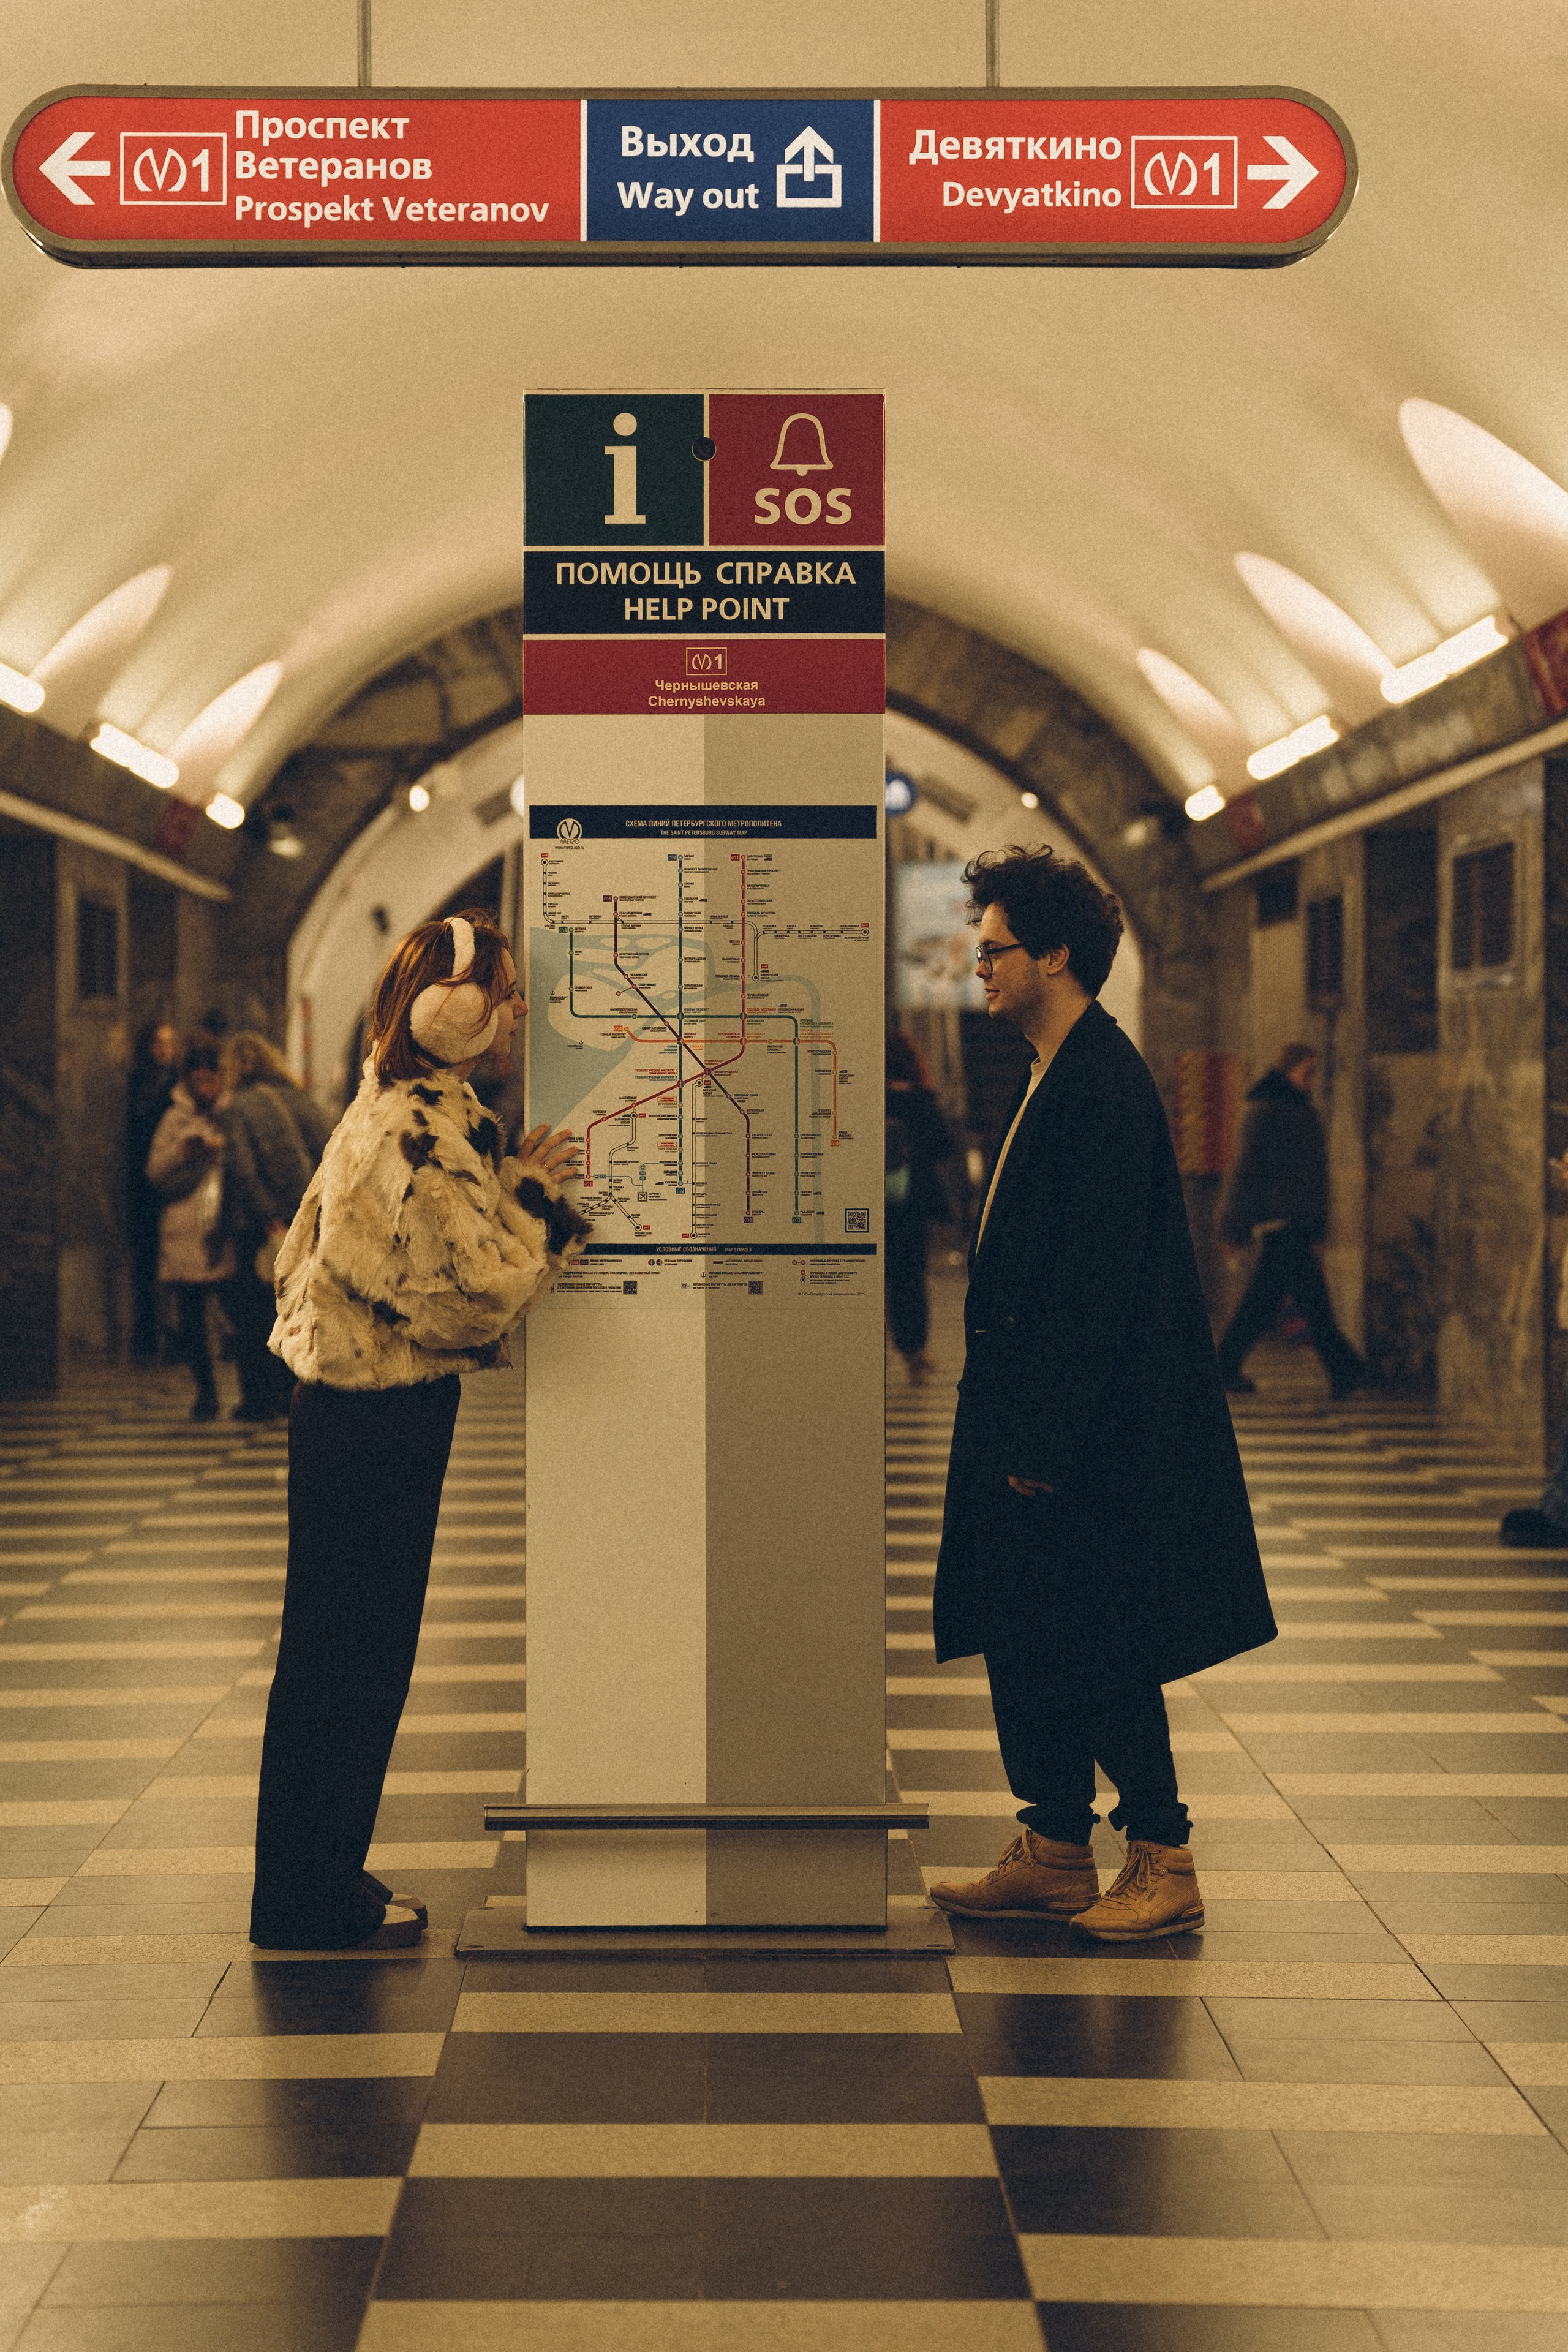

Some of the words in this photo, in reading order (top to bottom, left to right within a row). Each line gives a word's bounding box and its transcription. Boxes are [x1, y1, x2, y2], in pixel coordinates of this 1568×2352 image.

[236, 110, 409, 146] Проспект
[620, 126, 755, 162] Выход
[909, 129, 1121, 165] Девяткино
[236, 151, 432, 187] Ветеранов
[236, 194, 374, 228] Prospekt
[384, 197, 549, 223] Veteranov
[617, 181, 694, 216] Way
[703, 183, 759, 209] out
[943, 180, 1121, 216] Devyatkino
[754, 488, 852, 524] SOS
[556, 562, 701, 588] ПОМОЩЬ
[717, 562, 856, 584] СПРАВКА
[625, 598, 693, 620] HELP
[702, 598, 789, 620] POINT
[648, 695, 766, 708] Chernyshevskaya
[655, 679, 758, 692] Чернышевская
[648, 818, 669, 827] ЛИНИЙ
